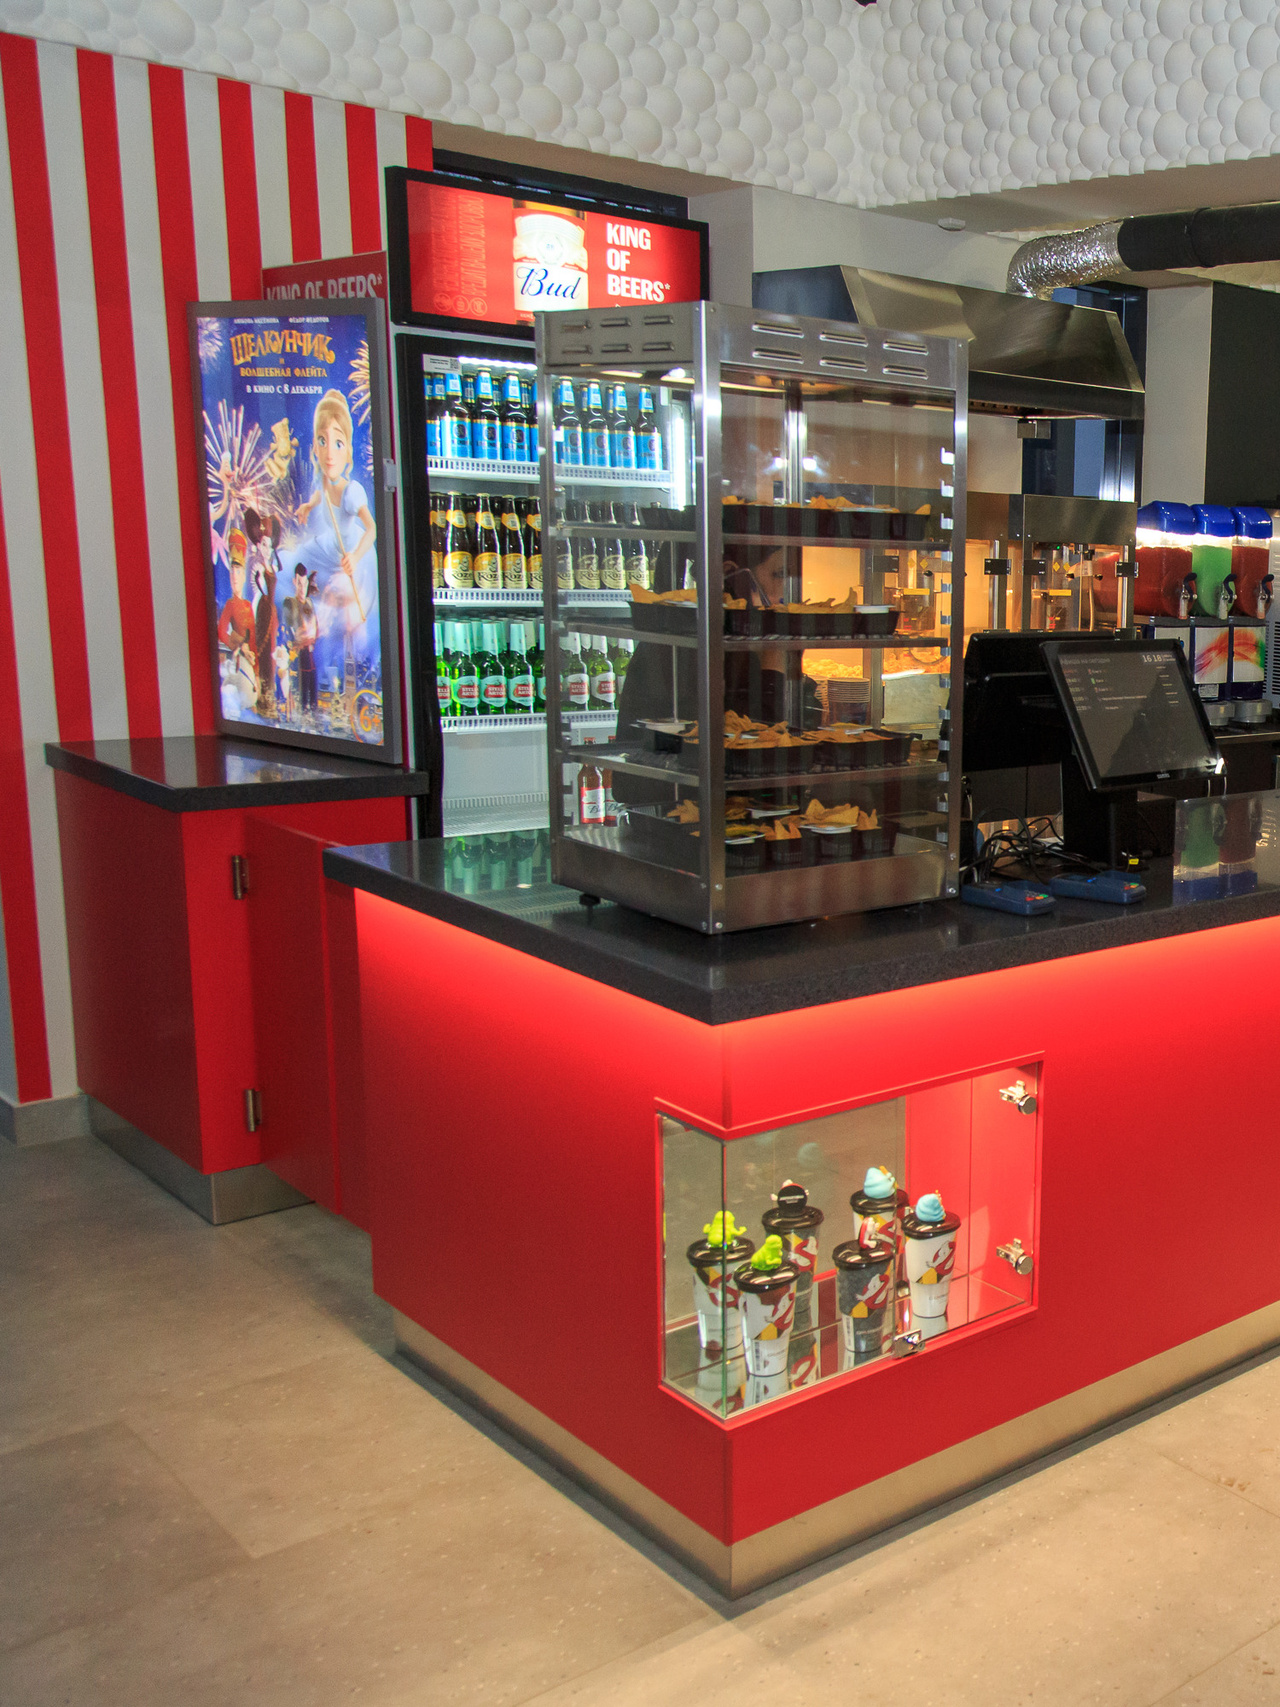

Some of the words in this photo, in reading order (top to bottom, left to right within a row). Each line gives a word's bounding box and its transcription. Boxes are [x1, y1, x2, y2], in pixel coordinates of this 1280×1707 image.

[607, 222, 651, 251] KING
[607, 248, 631, 272] OF
[516, 265, 582, 300] Bud
[230, 329, 335, 366] ЩЕЛКУНЧИК
[240, 367, 291, 377] ВОЛШЕБНАЯ
[294, 366, 328, 377] ФЛЕЙТА
[246, 385, 252, 393] В
[253, 385, 275, 394] КИНО
[276, 386, 282, 394] С
[283, 384, 289, 394] 8
[291, 386, 323, 394] ДЕКАБРЯ
[360, 705, 381, 732] 6+
